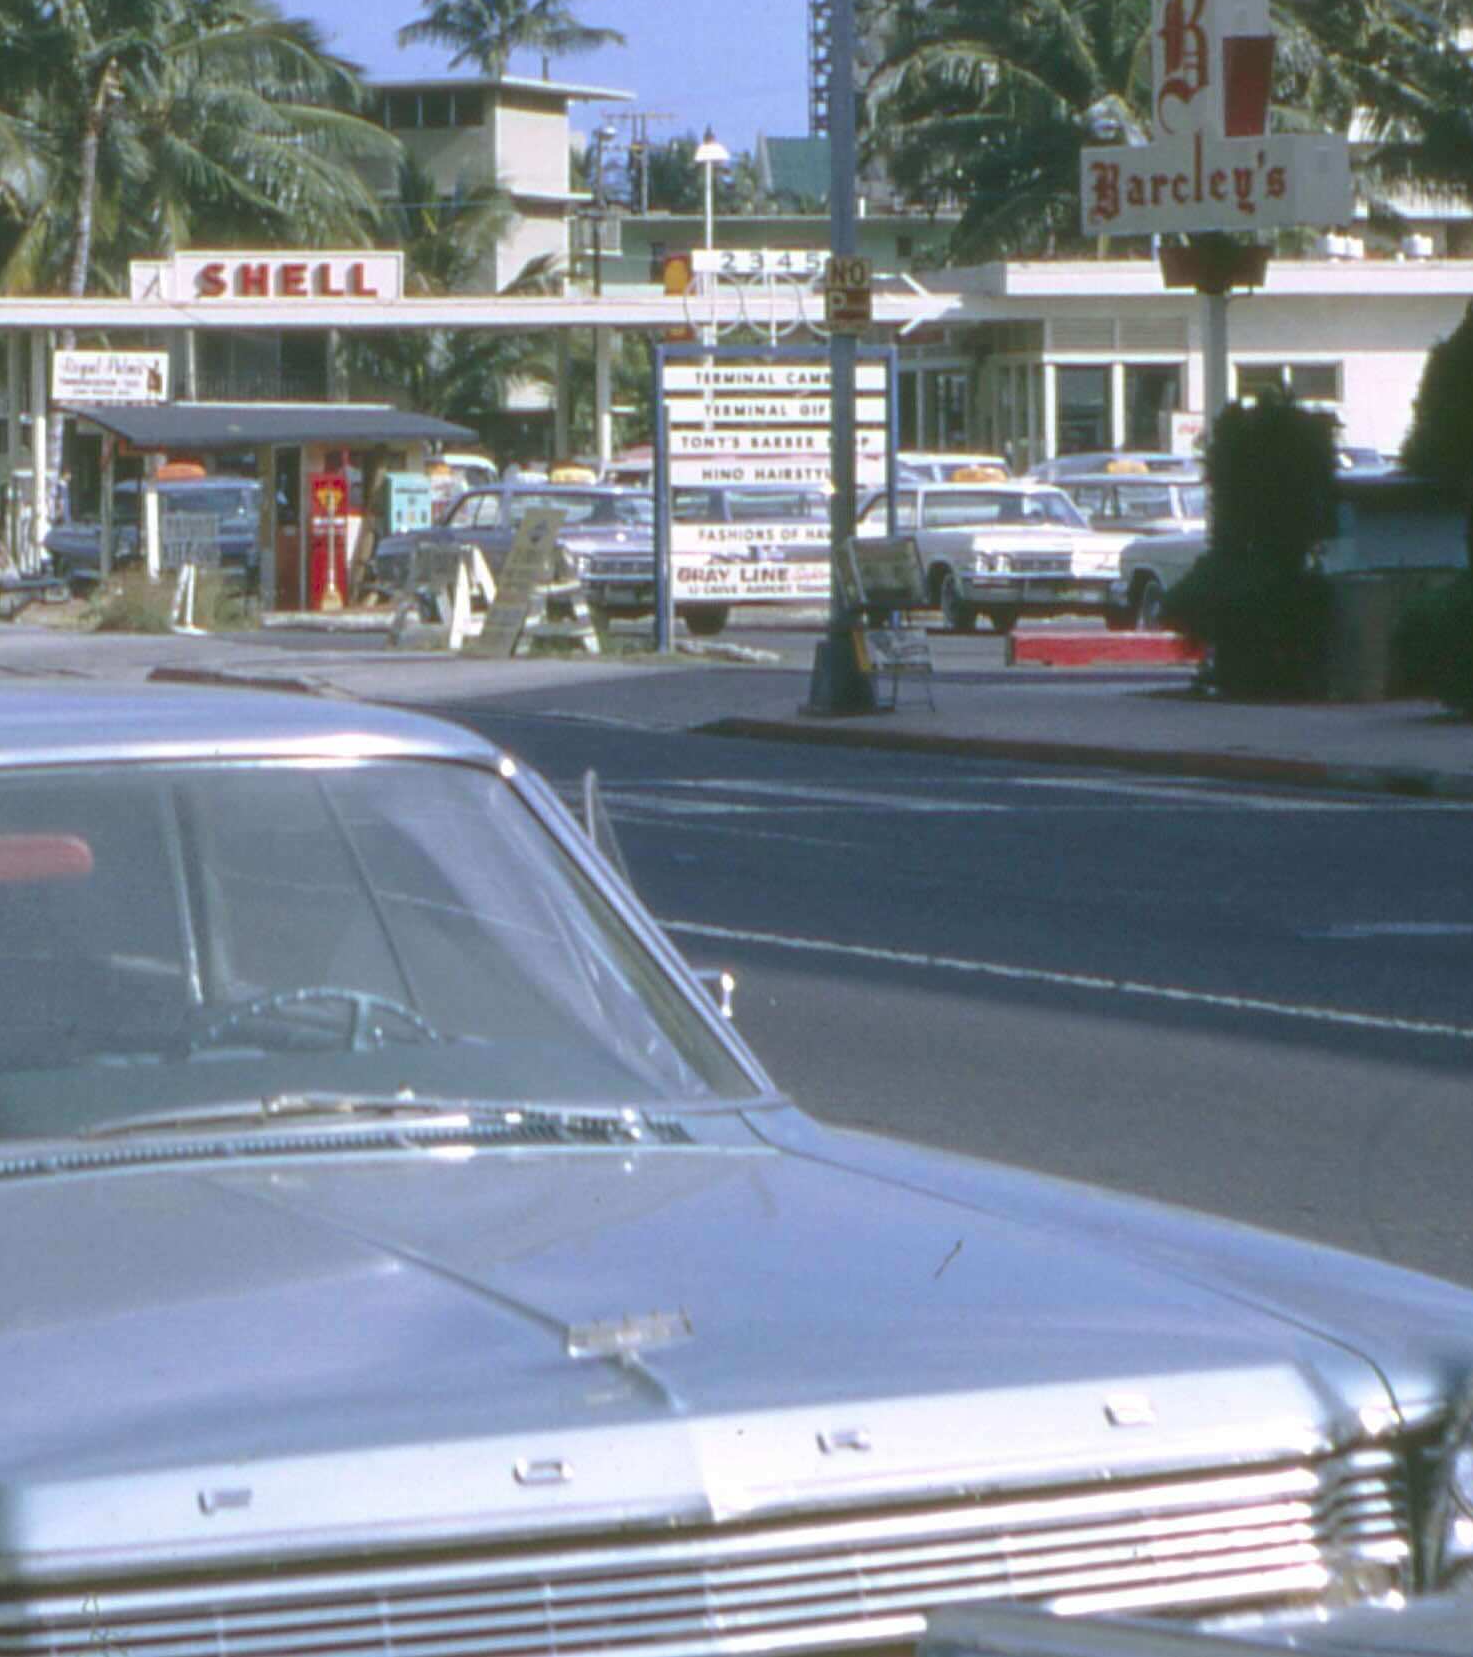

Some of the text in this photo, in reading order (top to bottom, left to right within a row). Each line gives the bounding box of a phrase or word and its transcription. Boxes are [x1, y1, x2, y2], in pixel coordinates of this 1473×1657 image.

[1088, 132, 1287, 222] Barcley's
[829, 259, 866, 286] NO
[196, 262, 378, 298] SHELL
[695, 372, 775, 385] TERMINAL
[705, 405, 831, 418] TERMINAL GIF
[682, 436, 741, 450] TONY'S
[750, 436, 815, 450] BARBER
[754, 468, 832, 482] HAIRSTYL
[699, 528, 774, 542] FASHIONS
[780, 528, 799, 541] OF
[676, 566, 728, 583] GRAY
[740, 566, 789, 583] LINE
